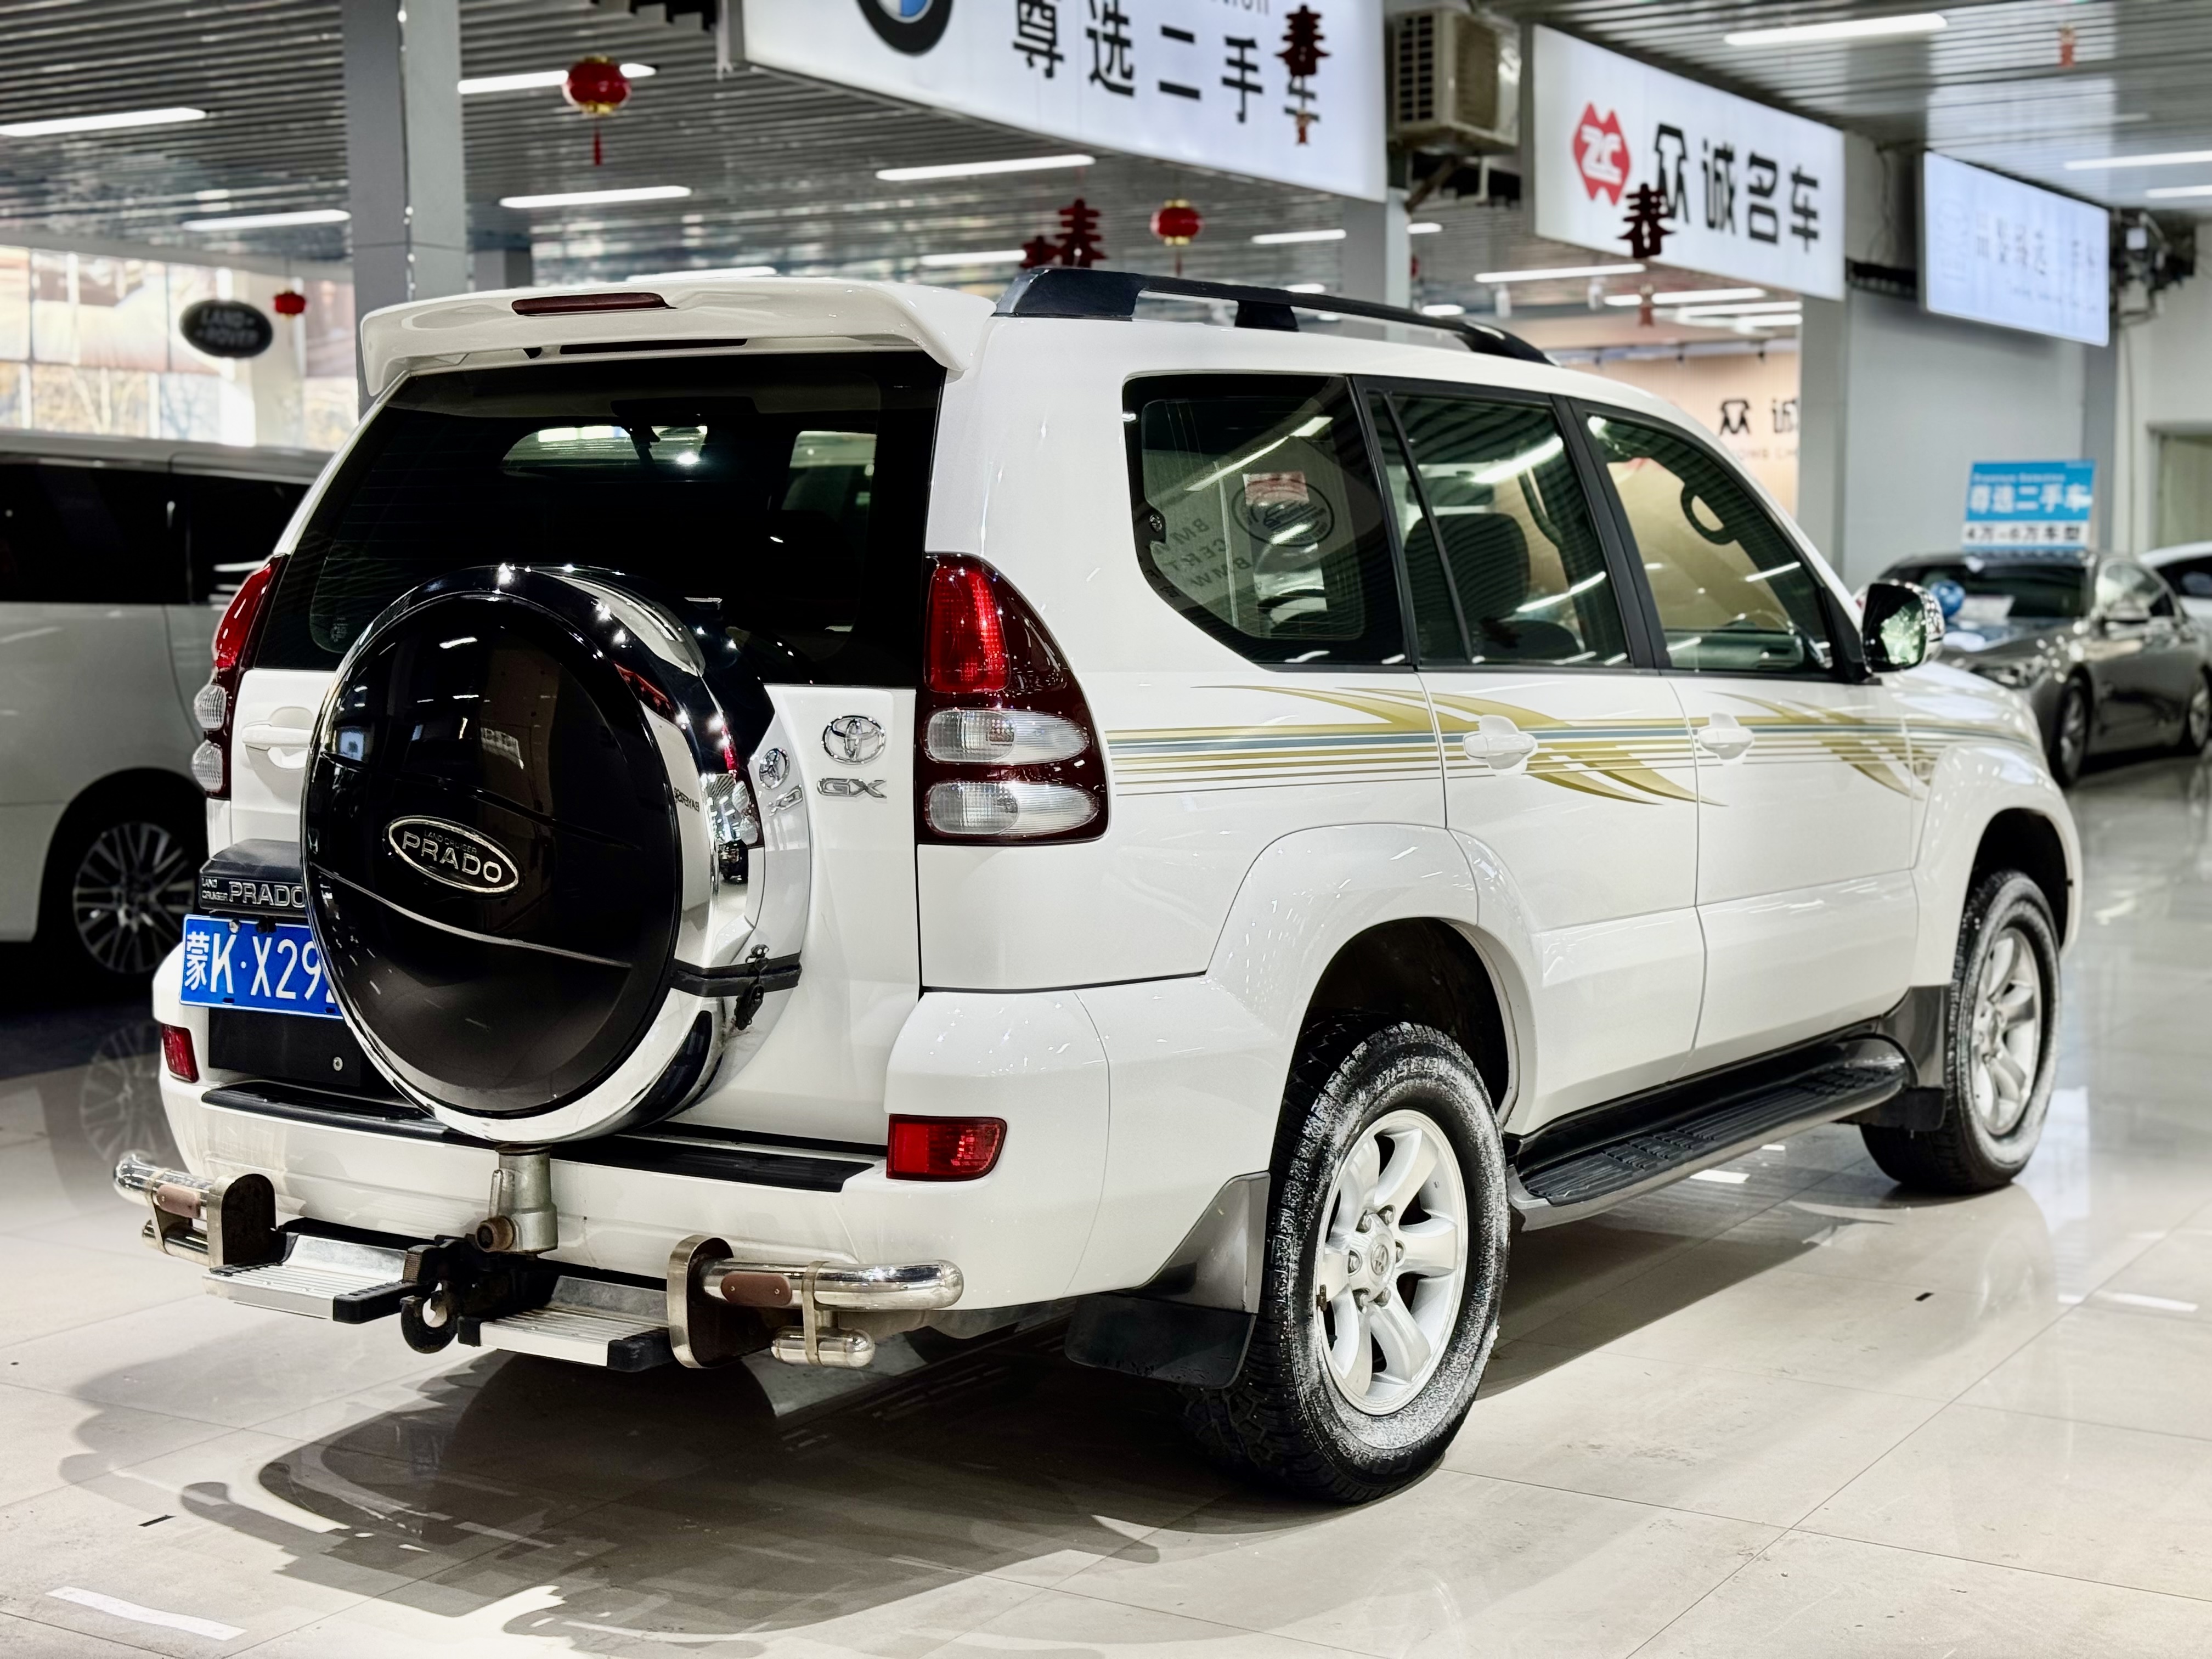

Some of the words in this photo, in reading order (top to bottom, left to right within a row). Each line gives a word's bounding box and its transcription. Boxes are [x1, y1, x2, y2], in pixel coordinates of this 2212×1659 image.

[1655, 123, 1819, 255] 众诚名车
[816, 777, 887, 799] GX
[424, 830, 443, 843] LAND
[444, 837, 477, 855] CRUISER
[402, 831, 502, 883] PRADO
[202, 878, 218, 888] LAND
[202, 890, 228, 901] CRUISER
[228, 881, 306, 908] PRADO
[184, 931, 336, 1004] 蒙K·X29
